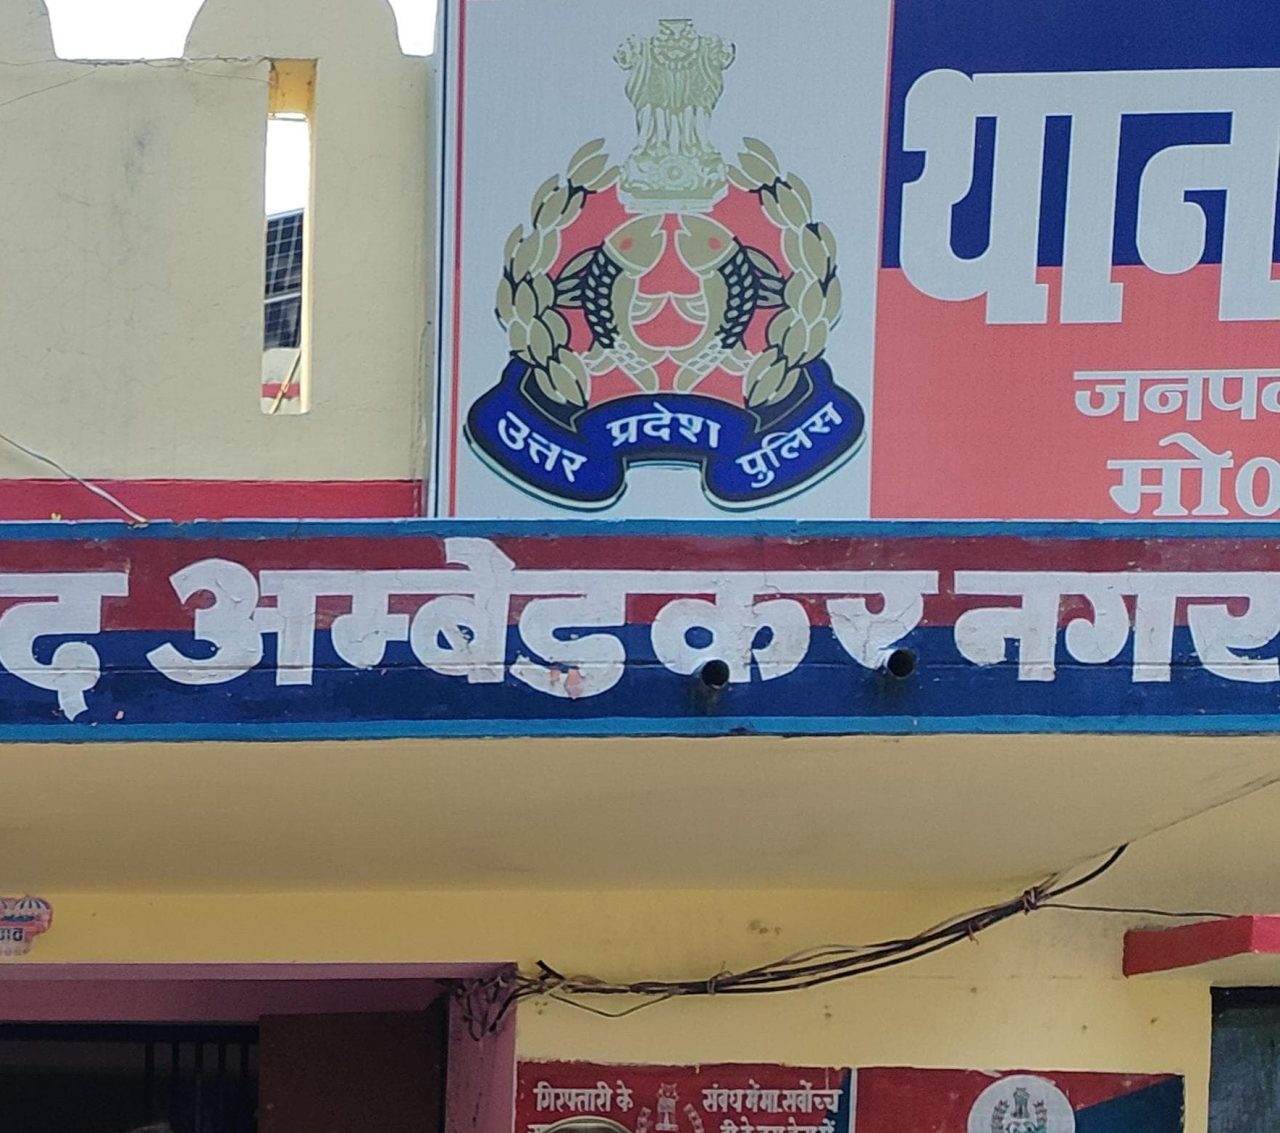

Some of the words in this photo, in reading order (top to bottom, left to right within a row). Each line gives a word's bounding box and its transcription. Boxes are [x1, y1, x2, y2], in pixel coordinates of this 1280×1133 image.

[497, 411, 587, 483] उत्तर
[607, 402, 721, 449] प्रदेश
[736, 402, 842, 487] पुलिस
[146, 537, 939, 700] अम्बेडकर
[953, 570, 1280, 684] नगर
[533, 1081, 613, 1112] गिरफ्तारी
[616, 1080, 634, 1112] के
[782, 1079, 844, 1113] सर्वोच्च
